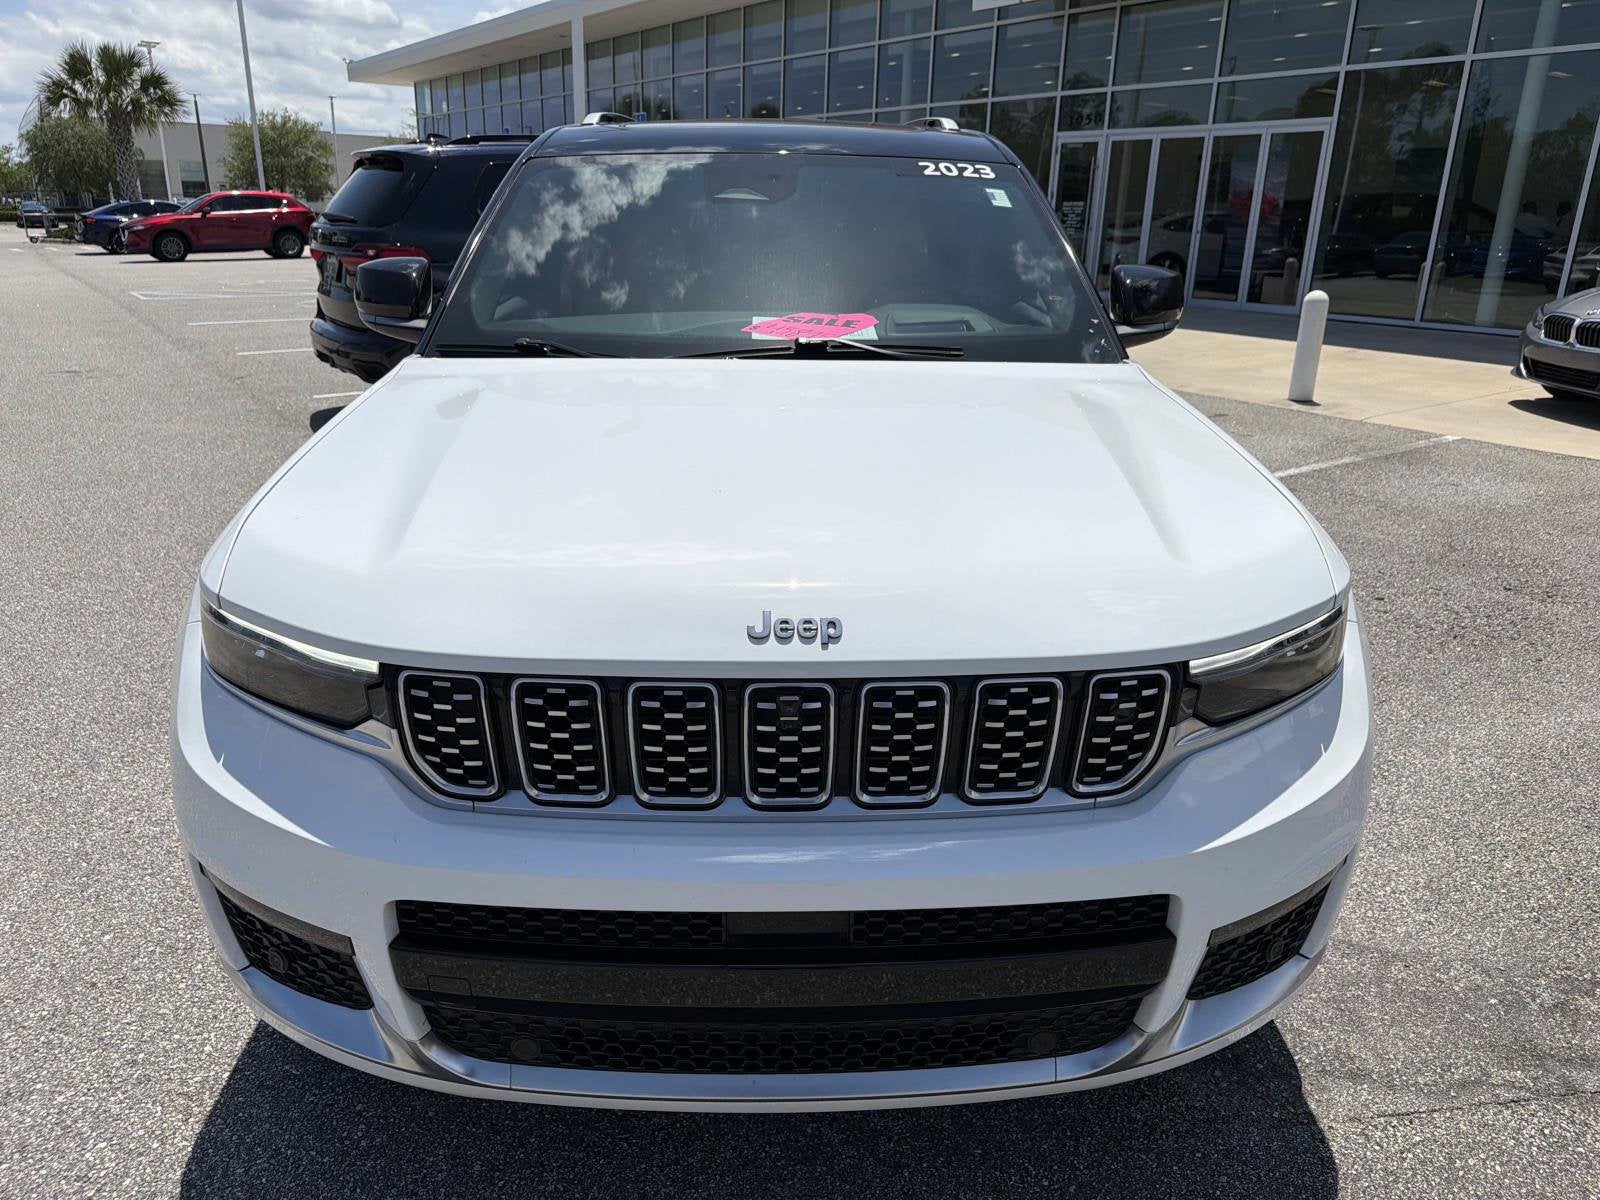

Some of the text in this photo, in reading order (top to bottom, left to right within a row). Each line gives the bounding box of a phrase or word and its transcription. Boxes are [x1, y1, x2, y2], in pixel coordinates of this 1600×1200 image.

[918, 161, 996, 179] 2023
[782, 316, 861, 328] SALE
[747, 609, 843, 649] Jeep
